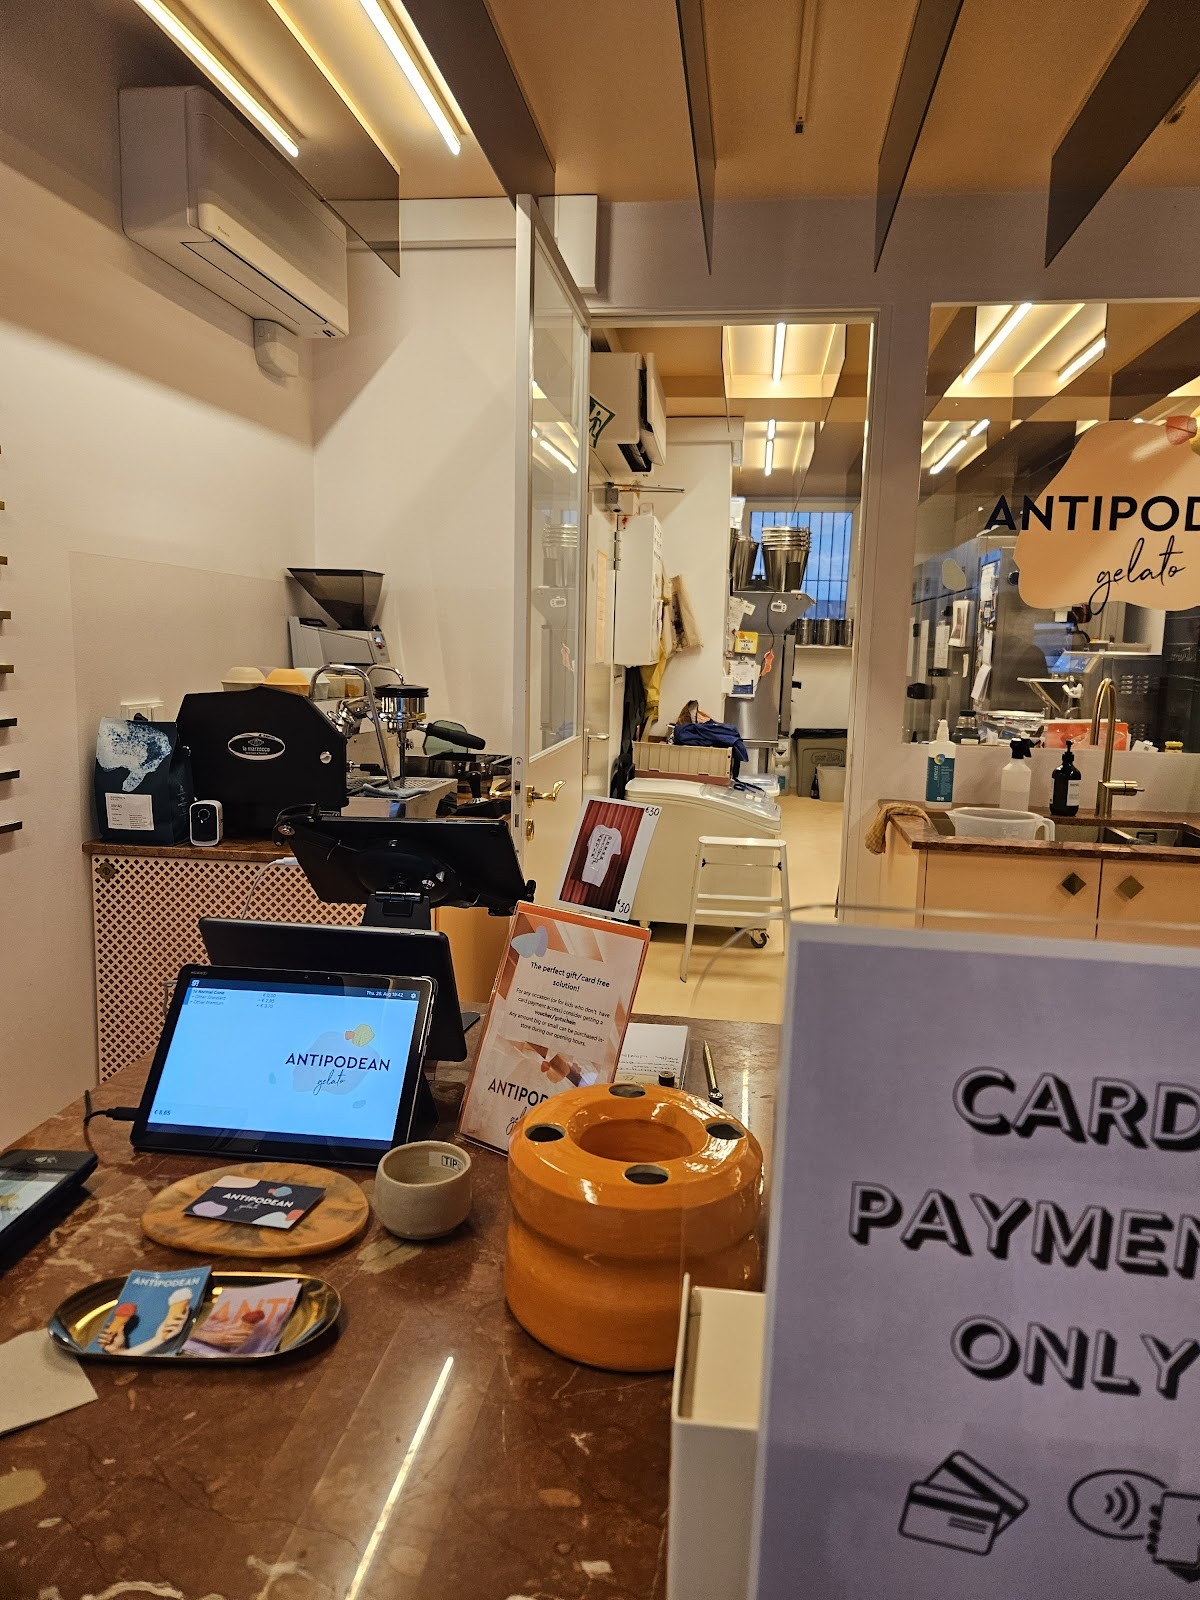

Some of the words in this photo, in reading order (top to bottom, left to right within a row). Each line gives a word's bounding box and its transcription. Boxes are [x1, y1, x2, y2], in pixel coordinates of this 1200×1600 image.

[1088, 534, 1187, 616] gelato
[646, 806, 660, 816] €30
[618, 898, 630, 914] €30
[531, 962, 542, 970] The
[542, 966, 565, 977] perfect
[566, 971, 597, 984] gift/card
[597, 978, 610, 988] free
[553, 980, 580, 992] solution!
[528, 1000, 546, 1009] payment
[563, 1010, 582, 1018] consider
[582, 1015, 599, 1024] getting
[532, 992, 550, 1001] occasion
[585, 1007, 597, 1015] don't
[517, 1014, 534, 1022] amount
[574, 1030, 597, 1041] purchased
[534, 1010, 576, 1025] voucher/gutschein
[532, 1025, 546, 1035] during
[554, 1033, 572, 1043] opening
[572, 1038, 586, 1046] hours.
[285, 1053, 390, 1071] ANTIPODEAN
[313, 1069, 346, 1095] gelato
[952, 1066, 1200, 1152] CARD
[222, 1193, 294, 1208] ANTIPODEAN
[132, 1276, 200, 1288] ANTIPODEAN
[951, 1314, 1200, 1400] ONLY
